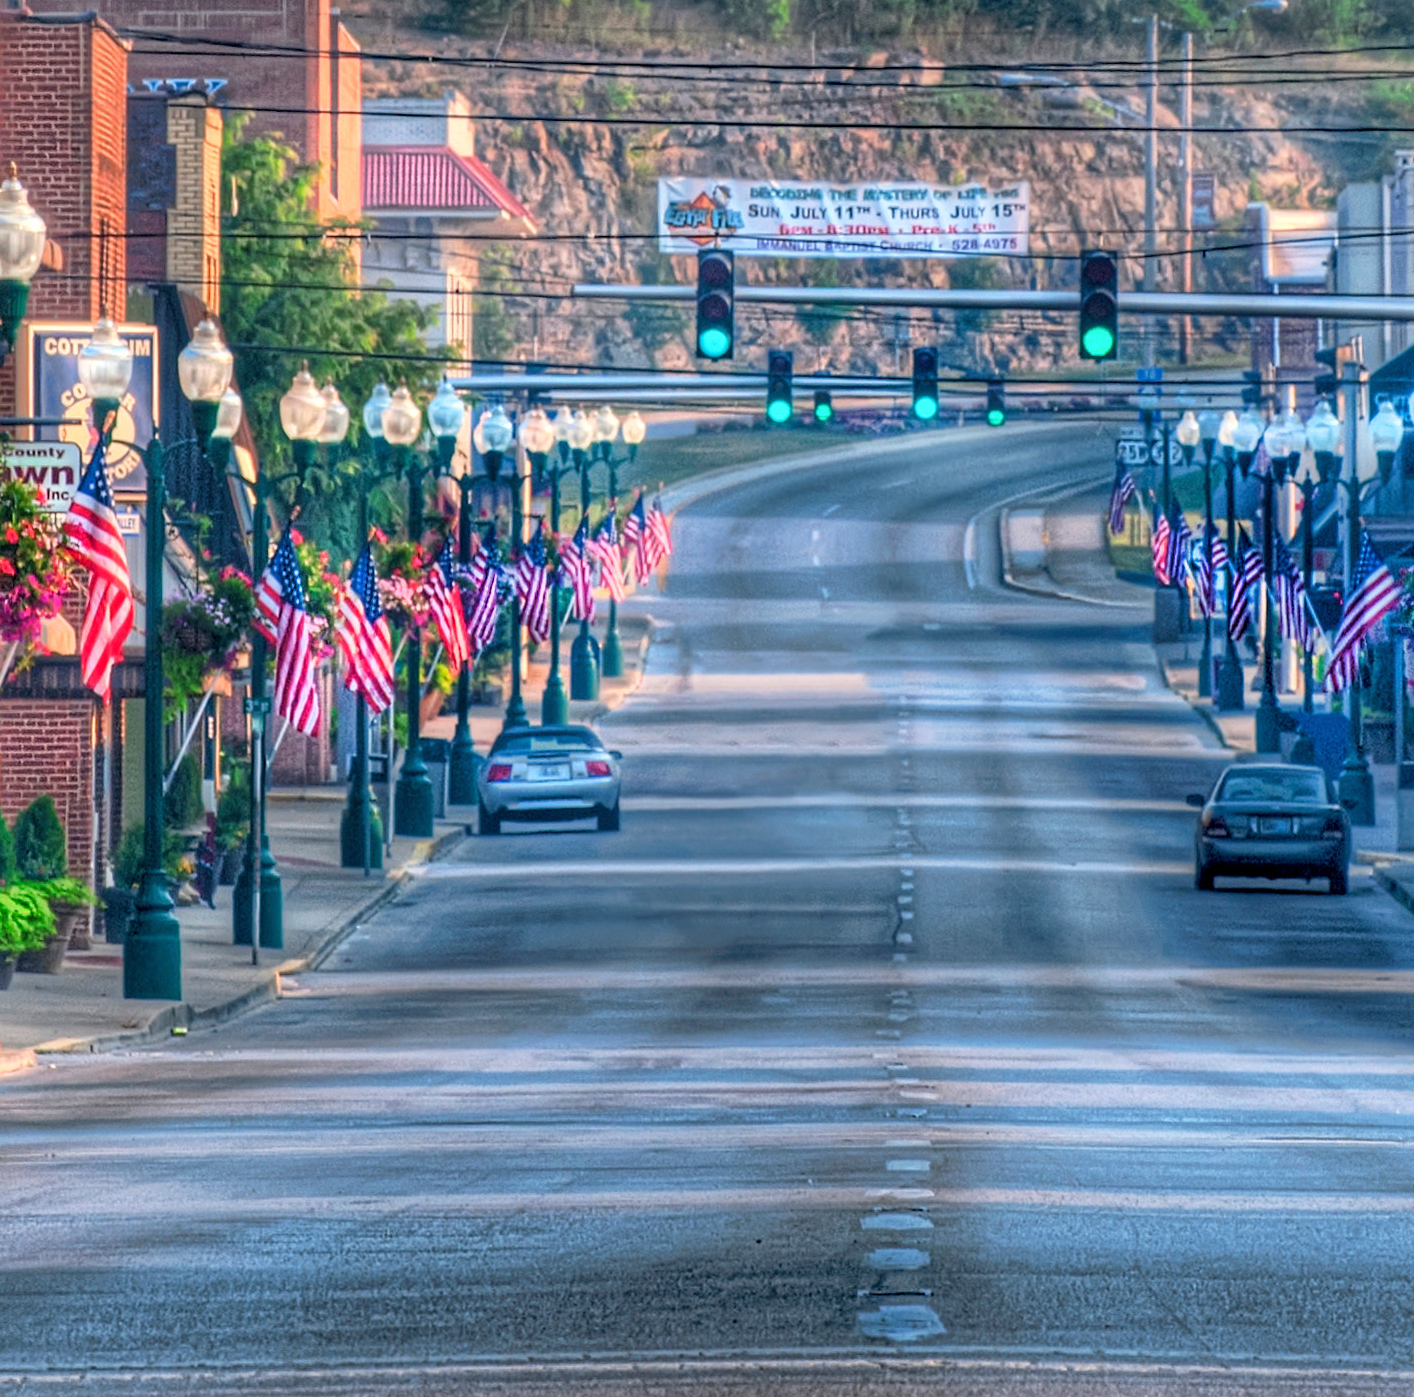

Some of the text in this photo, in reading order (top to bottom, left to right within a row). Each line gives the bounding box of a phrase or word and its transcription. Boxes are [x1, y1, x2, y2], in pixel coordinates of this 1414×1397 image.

[749, 187, 823, 200] DECODING
[829, 189, 857, 201] THE
[863, 188, 928, 201] MYSTERY
[933, 190, 952, 200] OF
[790, 206, 827, 220] JULY
[949, 205, 987, 219] JULY
[756, 239, 821, 252] IMMANUEL
[880, 240, 934, 252] CHURCH
